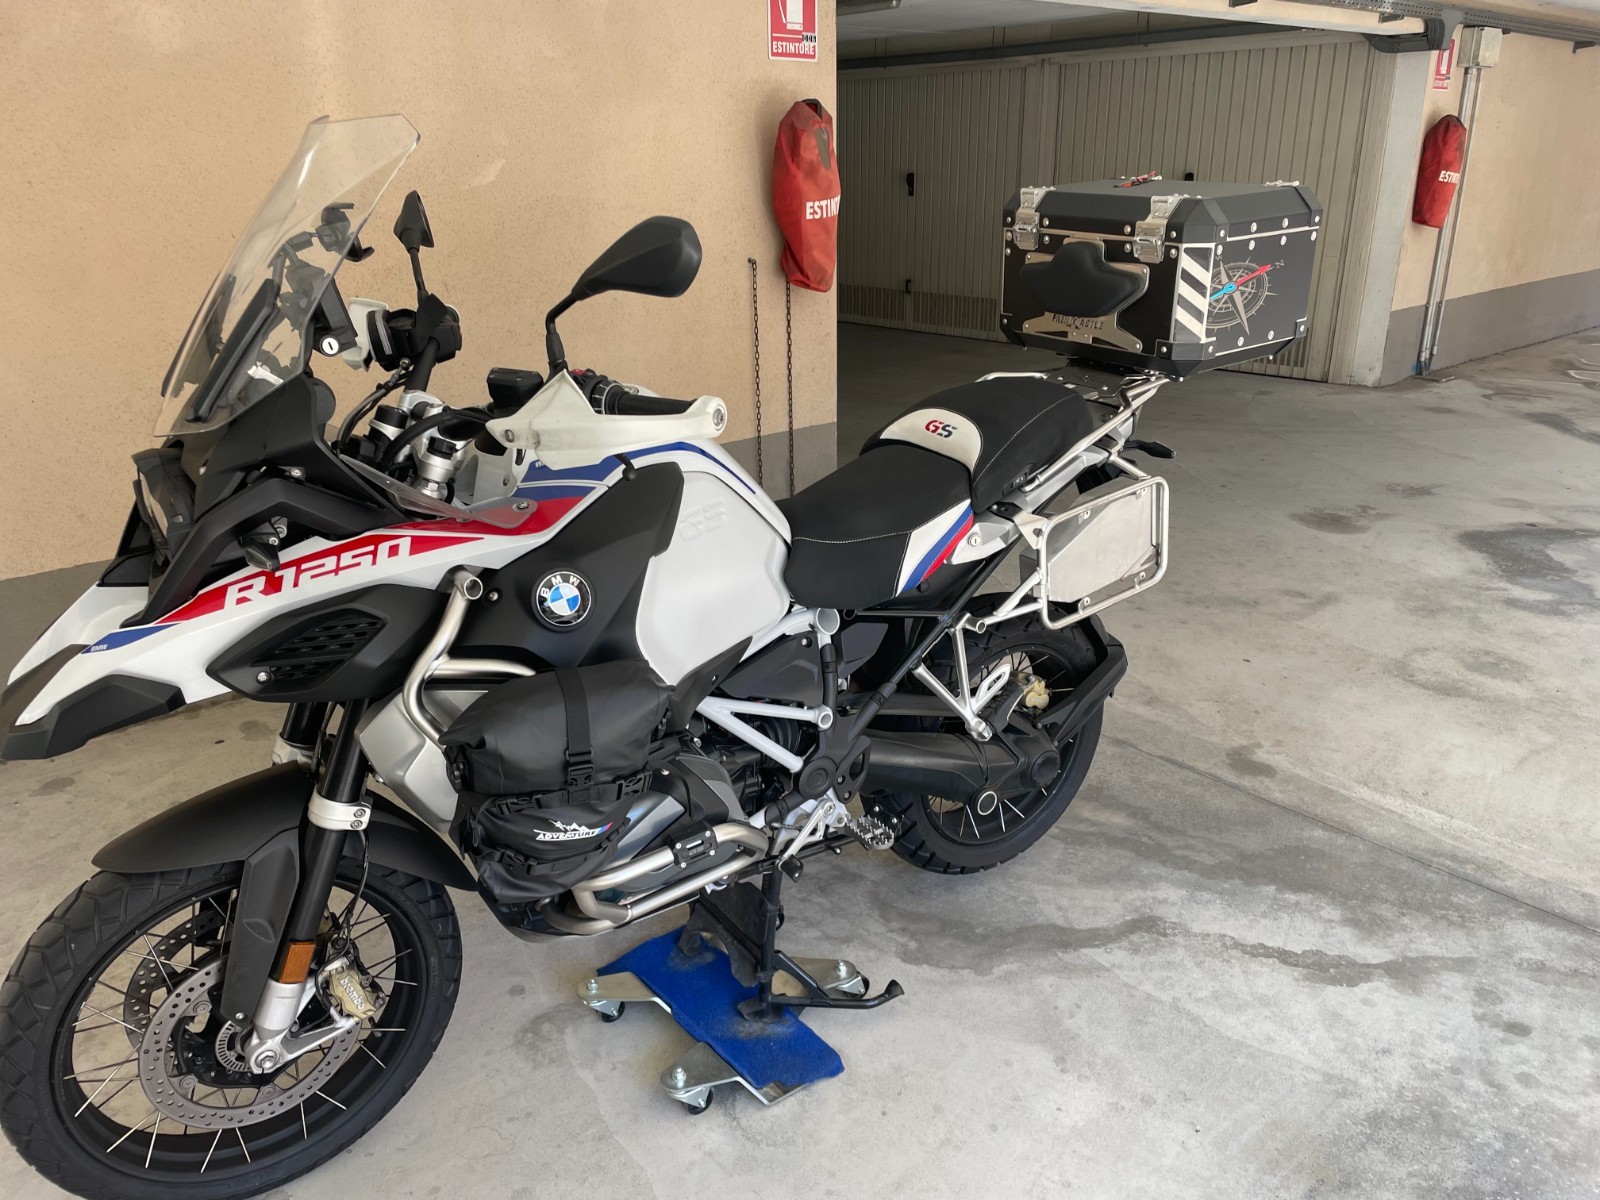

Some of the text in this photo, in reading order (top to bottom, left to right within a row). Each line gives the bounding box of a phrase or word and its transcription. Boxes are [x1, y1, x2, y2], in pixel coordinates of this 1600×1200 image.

[772, 41, 815, 55] ESTINTORE
[925, 419, 958, 438] GS
[223, 536, 412, 609] R1250
[540, 574, 581, 598] BMW
[536, 828, 598, 841] ADVENTURE
[340, 976, 365, 1010] brembo
